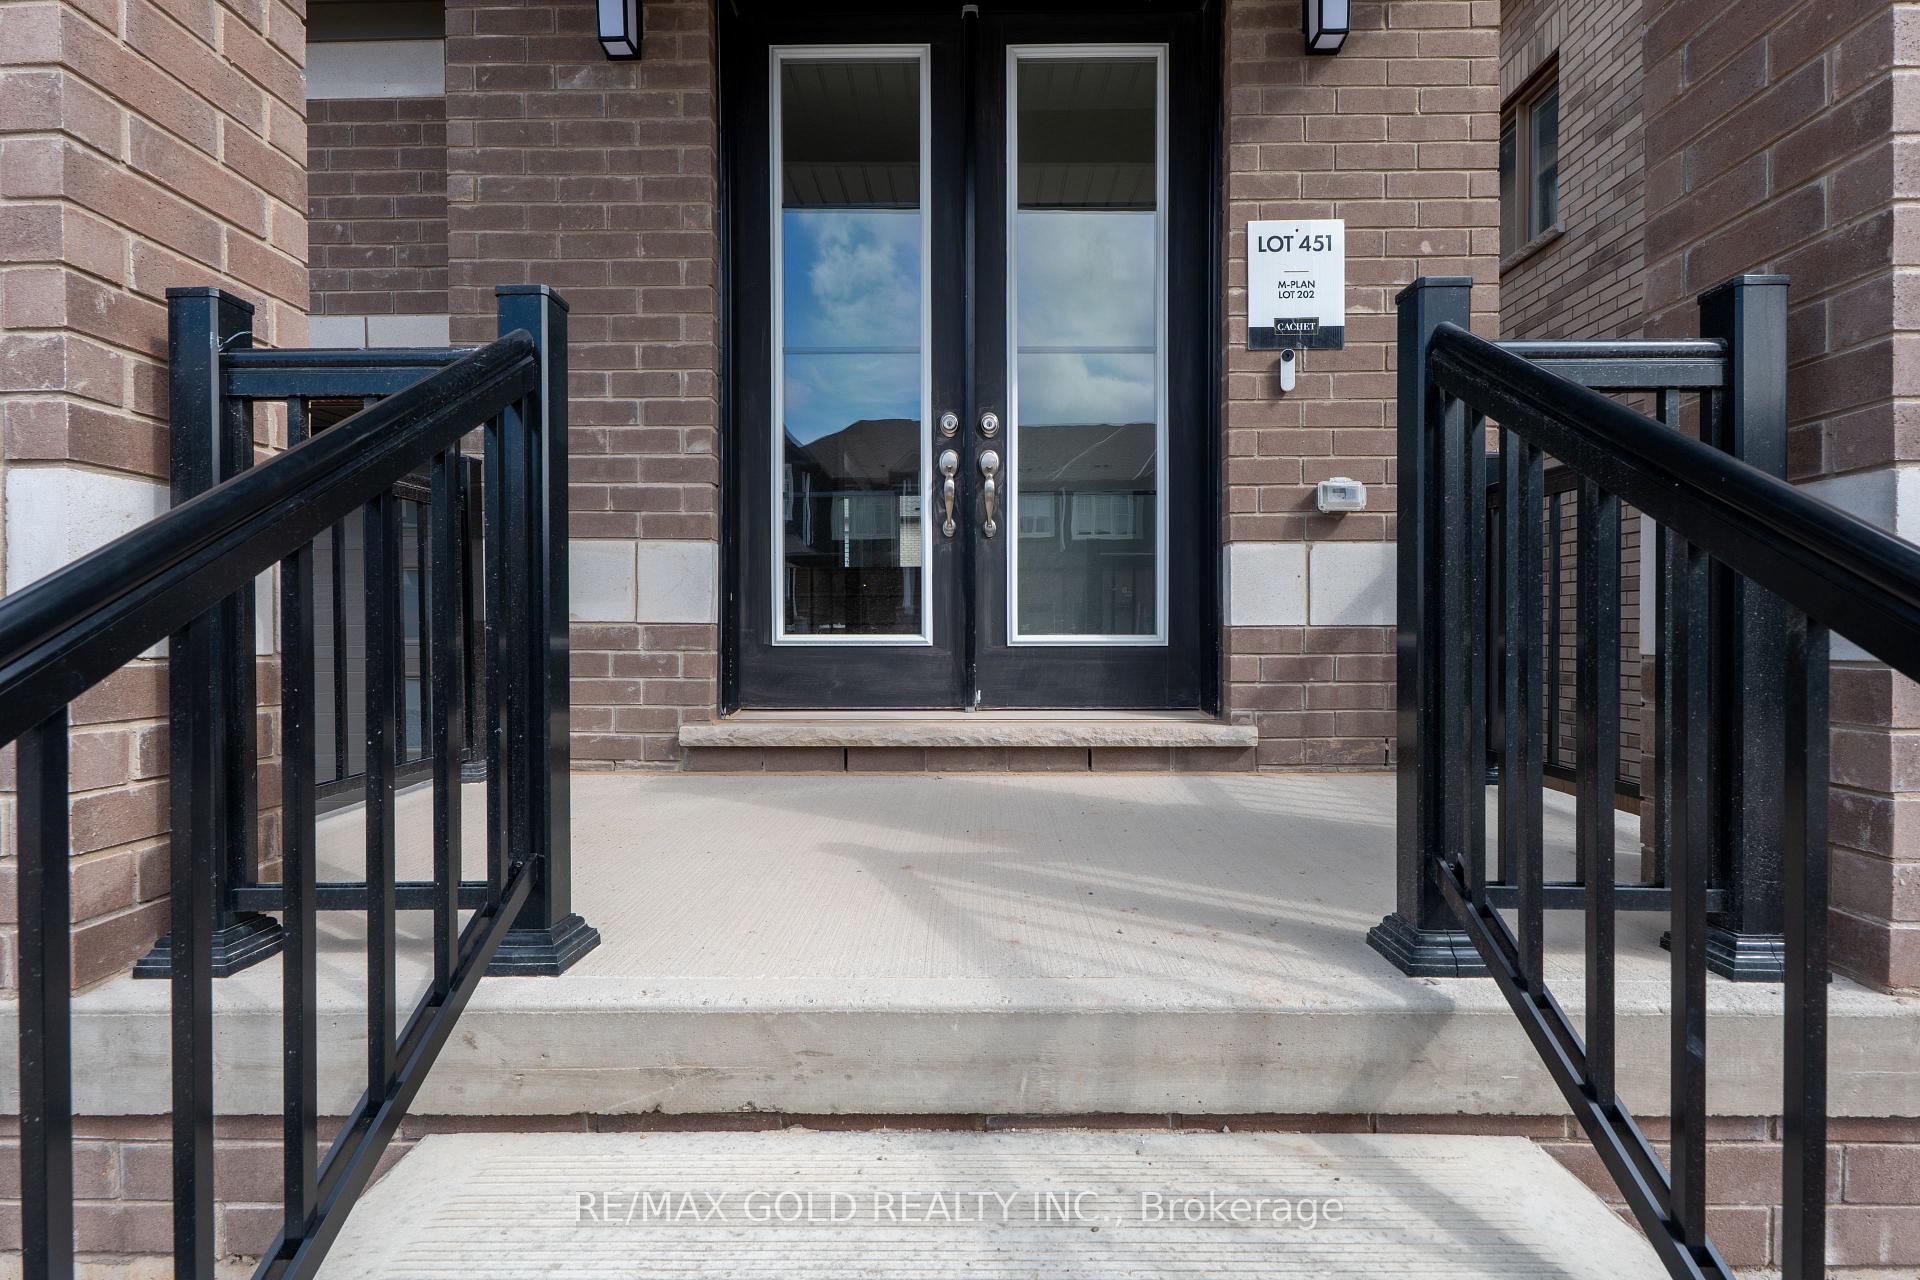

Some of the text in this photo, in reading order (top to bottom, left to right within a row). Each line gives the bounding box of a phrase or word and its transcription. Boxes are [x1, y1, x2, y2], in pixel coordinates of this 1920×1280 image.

[1258, 235, 1332, 252] LOT 451
[1278, 280, 1316, 289] M-PLAN
[1278, 290, 1315, 299] LOT 202
[1277, 322, 1316, 331] CACHET
